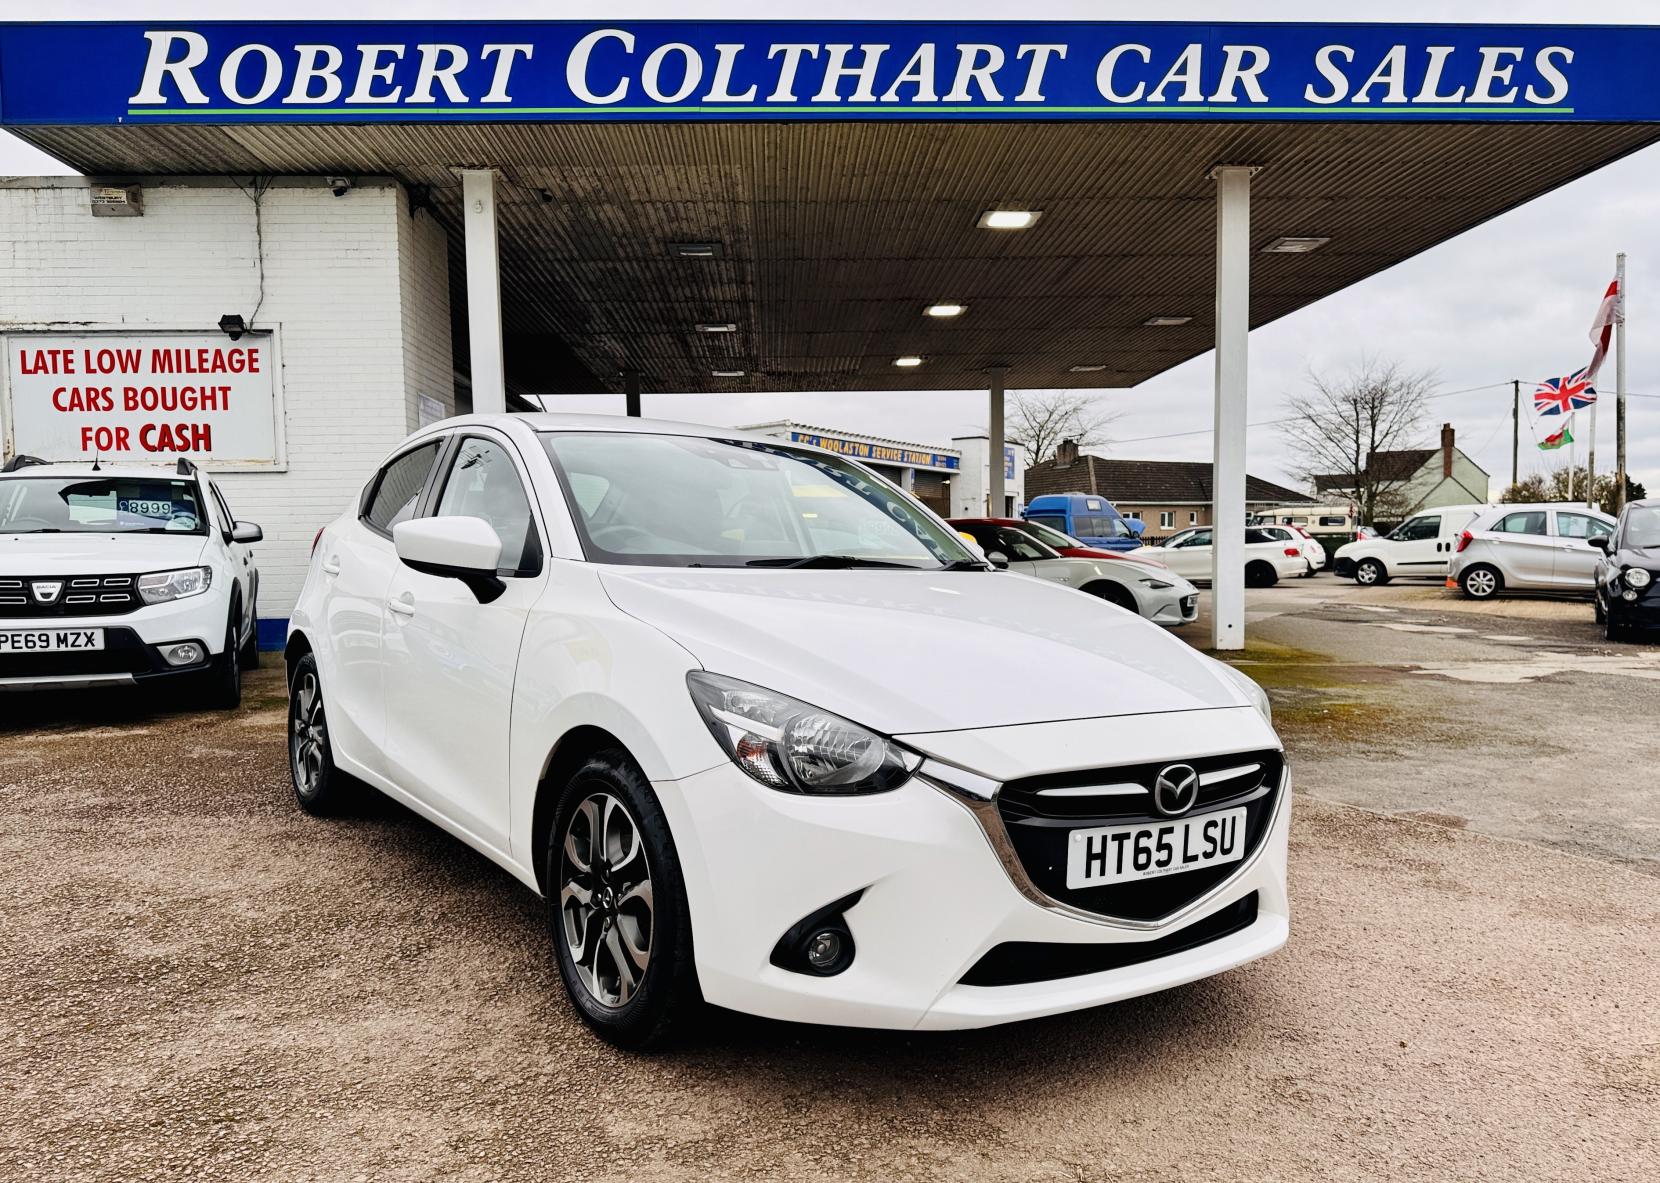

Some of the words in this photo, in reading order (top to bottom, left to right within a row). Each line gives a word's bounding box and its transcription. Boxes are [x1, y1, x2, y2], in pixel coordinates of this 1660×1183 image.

[128, 30, 534, 105] ROBERT
[566, 28, 1068, 105] COLTHART
[1096, 43, 1270, 104] CAR
[1304, 44, 1575, 105] SALES
[20, 349, 75, 374] LATE
[84, 349, 142, 374] LOW
[151, 348, 260, 374] MILEAGE
[52, 387, 113, 412] CARS
[124, 386, 232, 412] BOUGHT
[81, 426, 130, 452] FOR
[139, 423, 212, 452] CASH
[819, 437, 869, 457] WOOLASTON
[871, 446, 902, 461] SERVICE
[904, 450, 931, 465] STATION
[0, 633, 50, 650] PE69
[56, 631, 96, 649] MZX
[1084, 826, 1175, 879] HT65
[1182, 815, 1237, 864] LSU
